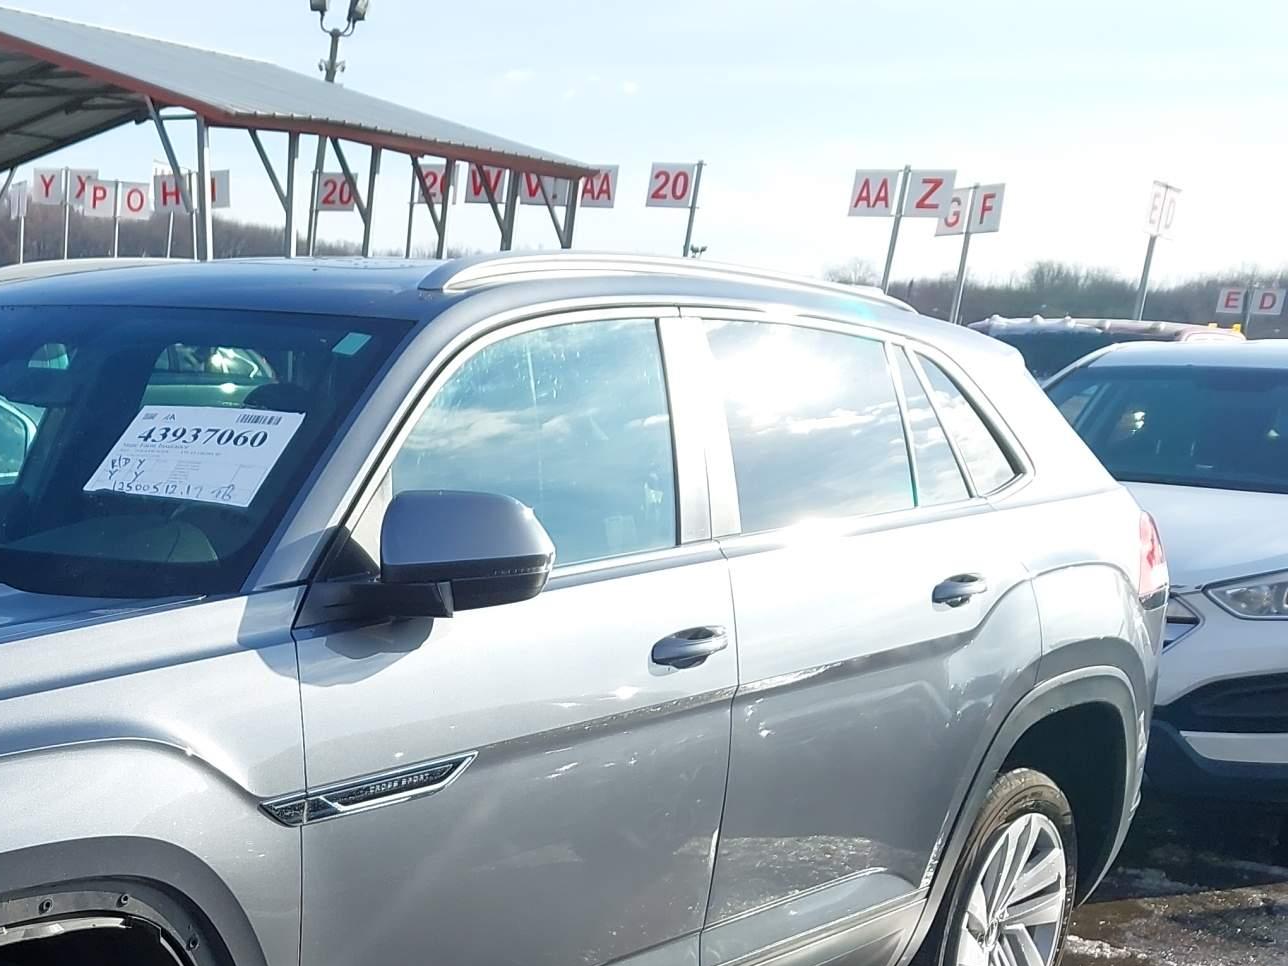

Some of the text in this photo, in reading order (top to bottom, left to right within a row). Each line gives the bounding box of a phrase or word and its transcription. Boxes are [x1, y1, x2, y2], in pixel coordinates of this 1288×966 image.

[40, 174, 55, 198] Y
[92, 186, 107, 209] P
[161, 181, 181, 206] H
[322, 178, 352, 205] 20
[582, 172, 611, 201] AA
[651, 170, 690, 200] 20
[853, 177, 890, 209] AA
[915, 178, 946, 210] Z
[126, 188, 145, 212] O
[944, 197, 962, 228] G
[978, 192, 996, 224] F
[1224, 291, 1241, 308] E
[1259, 292, 1277, 310] D
[137, 426, 268, 448] 43937060
